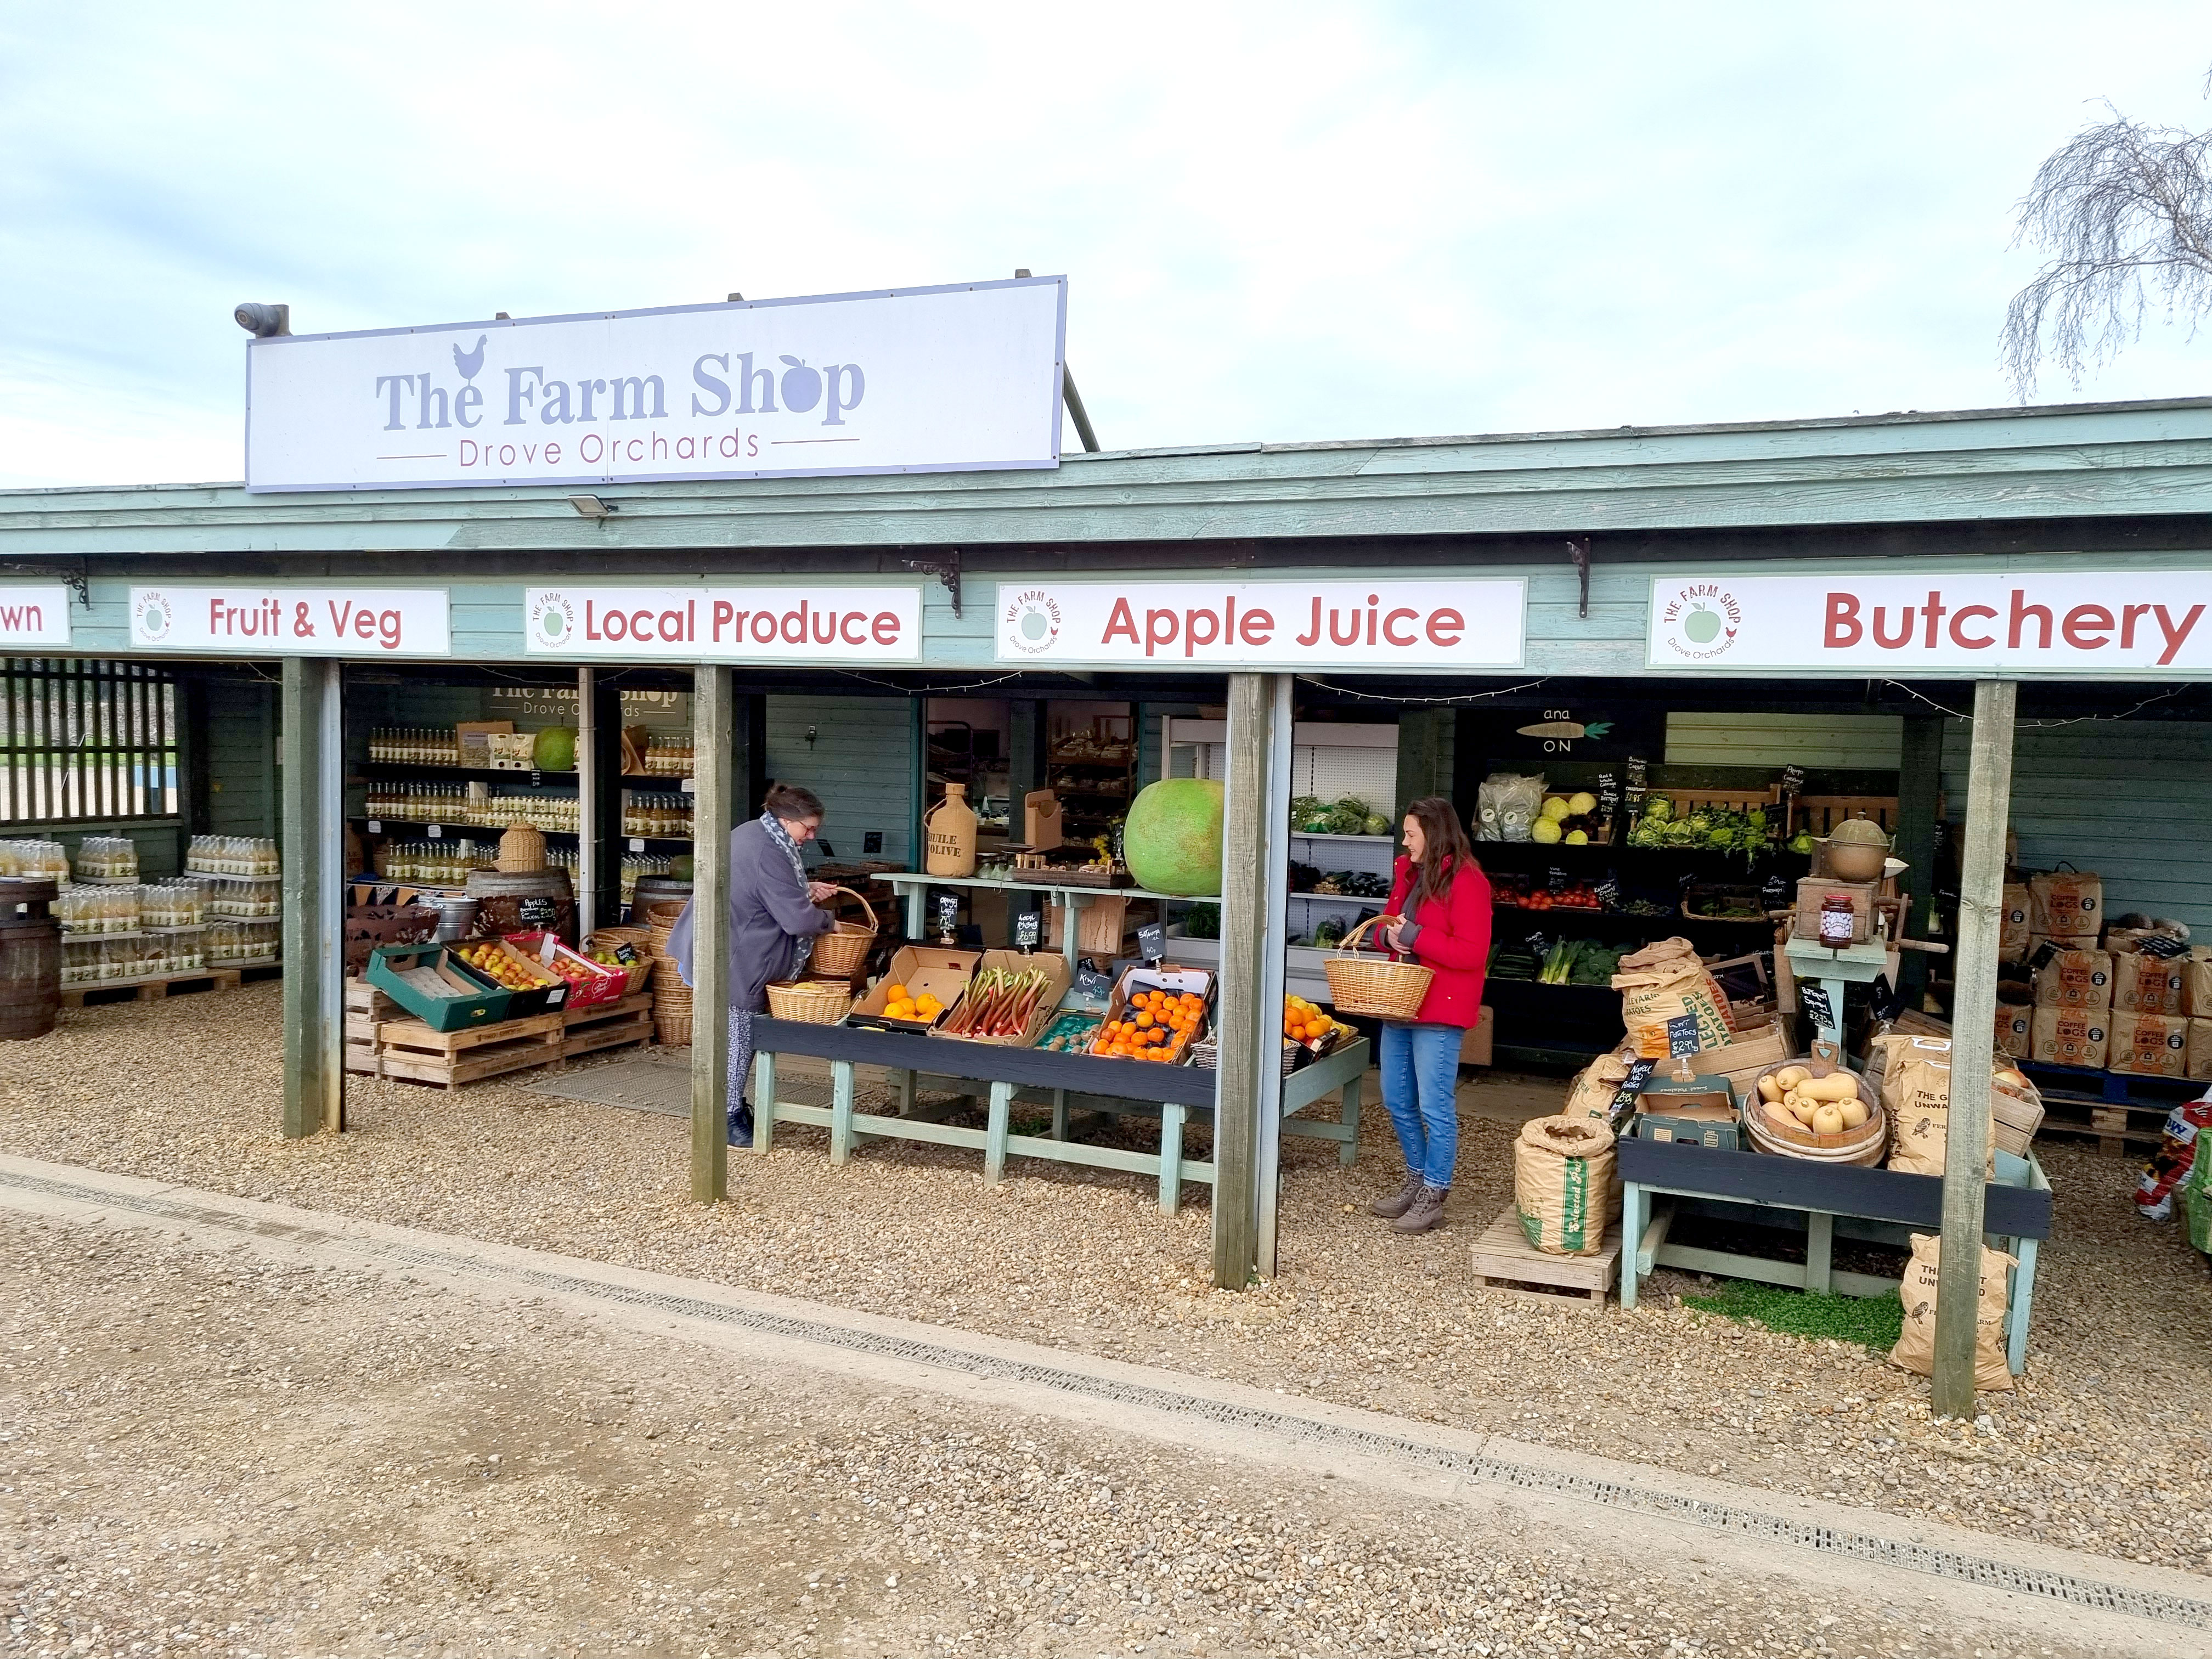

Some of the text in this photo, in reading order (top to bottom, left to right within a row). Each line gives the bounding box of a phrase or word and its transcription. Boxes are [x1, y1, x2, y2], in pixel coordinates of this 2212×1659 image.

[376, 352, 865, 431] The Farm Shop
[461, 427, 758, 467] Drove Orchards
[137, 592, 172, 619] THE FARM SHOP
[532, 592, 574, 622] THE FARM SHOP
[1007, 590, 1062, 624] THE FARM SHOP
[1664, 584, 1742, 624] THE FARM SHOP
[211, 599, 402, 650] Fruit & Veg
[586, 600, 901, 646] Local Produce
[1101, 594, 1465, 657] Apple Juice
[1823, 589, 2207, 665] Butchery
[535, 631, 572, 648] Drove Orchards
[1009, 635, 1058, 654] Drove Orchards
[1667, 637, 1735, 659] Drove Orchards
[524, 702, 565, 715] Drove
[1543, 740, 1571, 752] ON
[2057, 1020, 2086, 1029] COFFEE
[2057, 1027, 2086, 1037] LOGS
[2134, 1036, 2165, 1046] LOGS
[1916, 1090, 1937, 1101] THE
[1568, 1186, 1581, 1233] Selected
